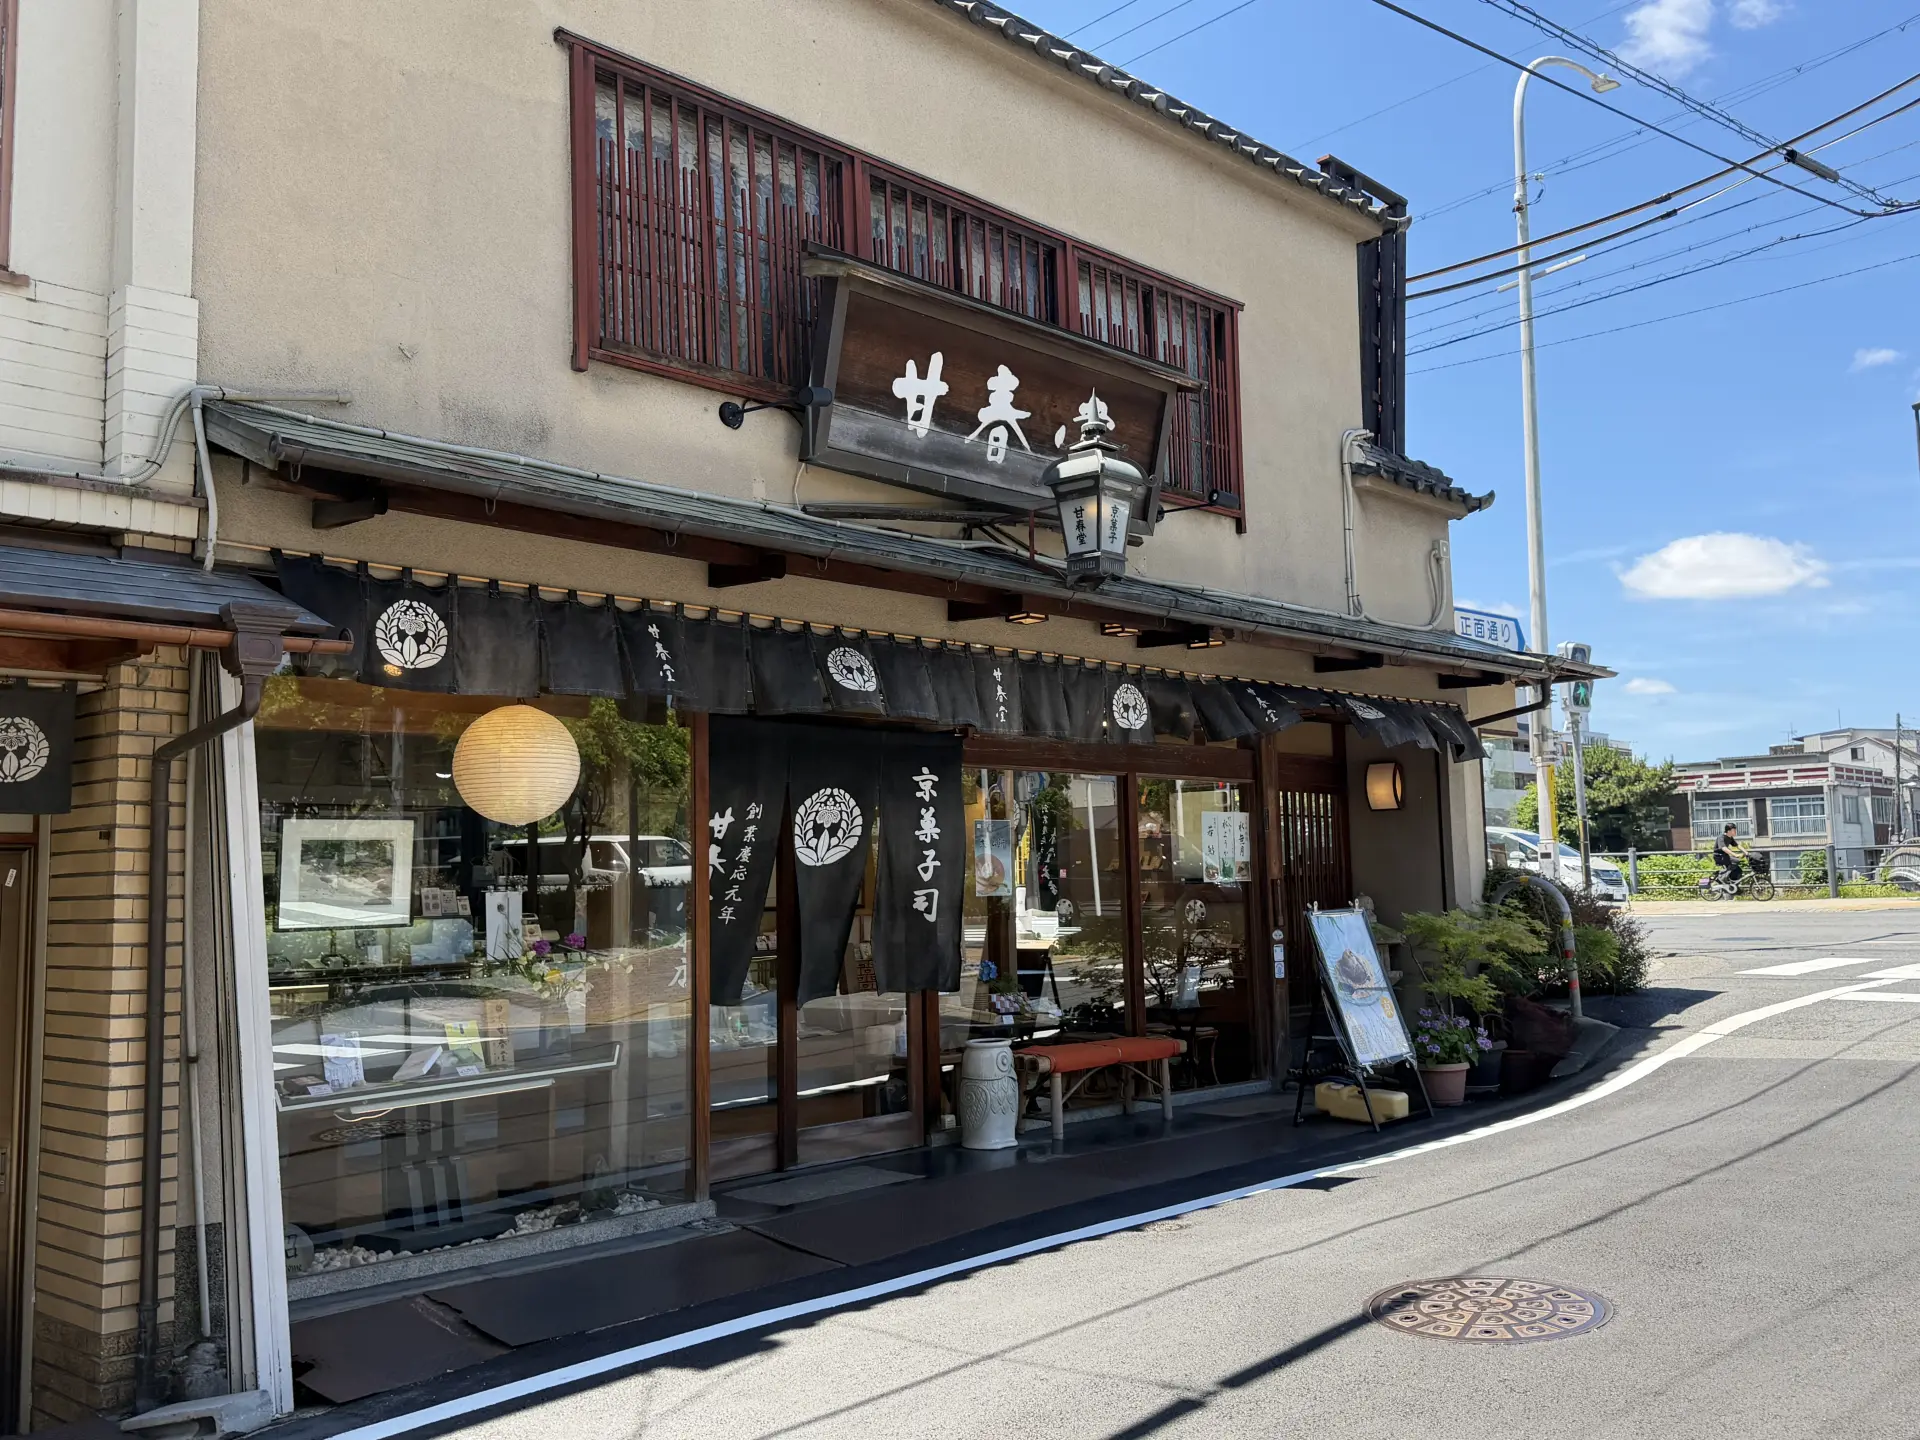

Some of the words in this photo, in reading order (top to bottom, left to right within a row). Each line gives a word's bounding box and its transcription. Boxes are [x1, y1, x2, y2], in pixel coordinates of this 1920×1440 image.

[1073, 506, 1087, 546] 甘春堂
[1108, 504, 1119, 544] 京菓子
[648, 623, 676, 682] 甘春堂
[1460, 616, 1511, 643] 正面通り
[993, 667, 1008, 722] 甘春堂
[718, 802, 763, 924] 創業慶応元年
[912, 766, 941, 923] 京菓子司
